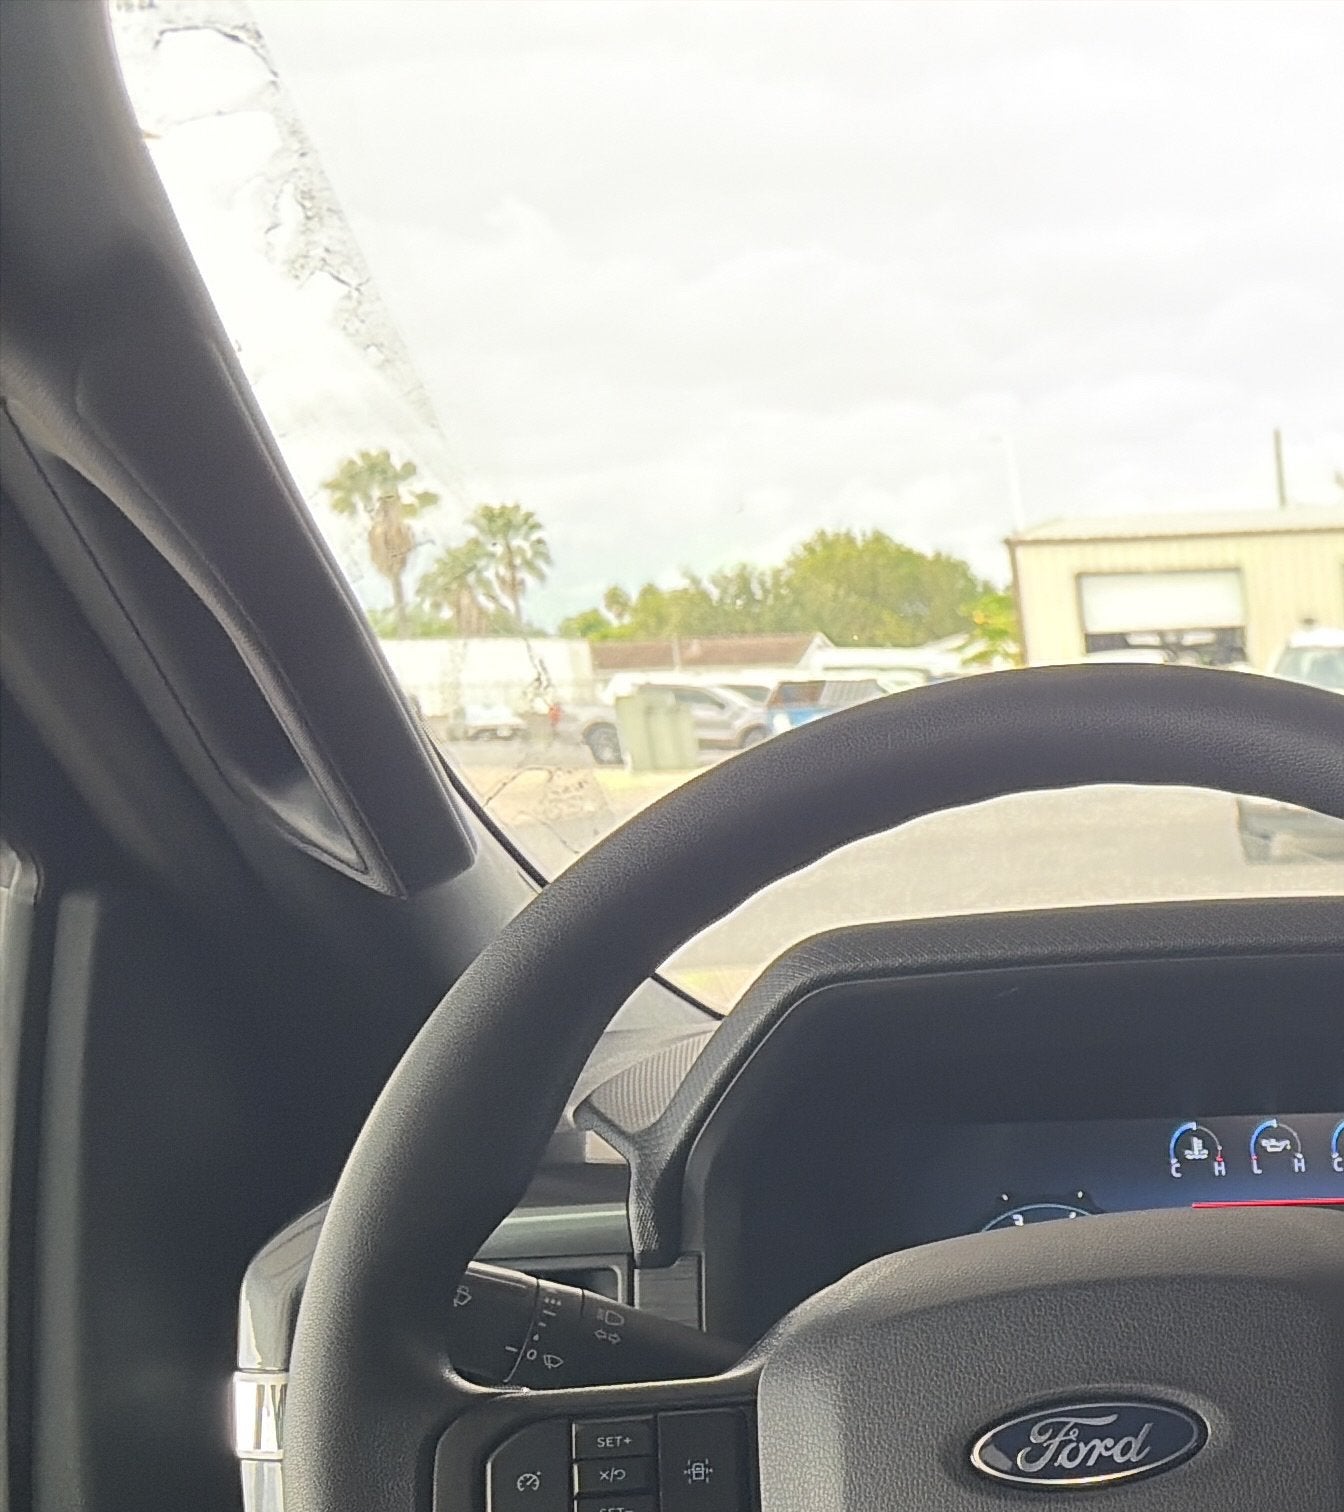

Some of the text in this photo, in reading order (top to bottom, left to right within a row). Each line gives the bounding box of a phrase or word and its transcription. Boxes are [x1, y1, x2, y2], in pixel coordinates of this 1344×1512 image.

[1214, 1162, 1226, 1176] H
[1294, 1157, 1306, 1172] H
[1016, 1413, 1154, 1473] Ford
